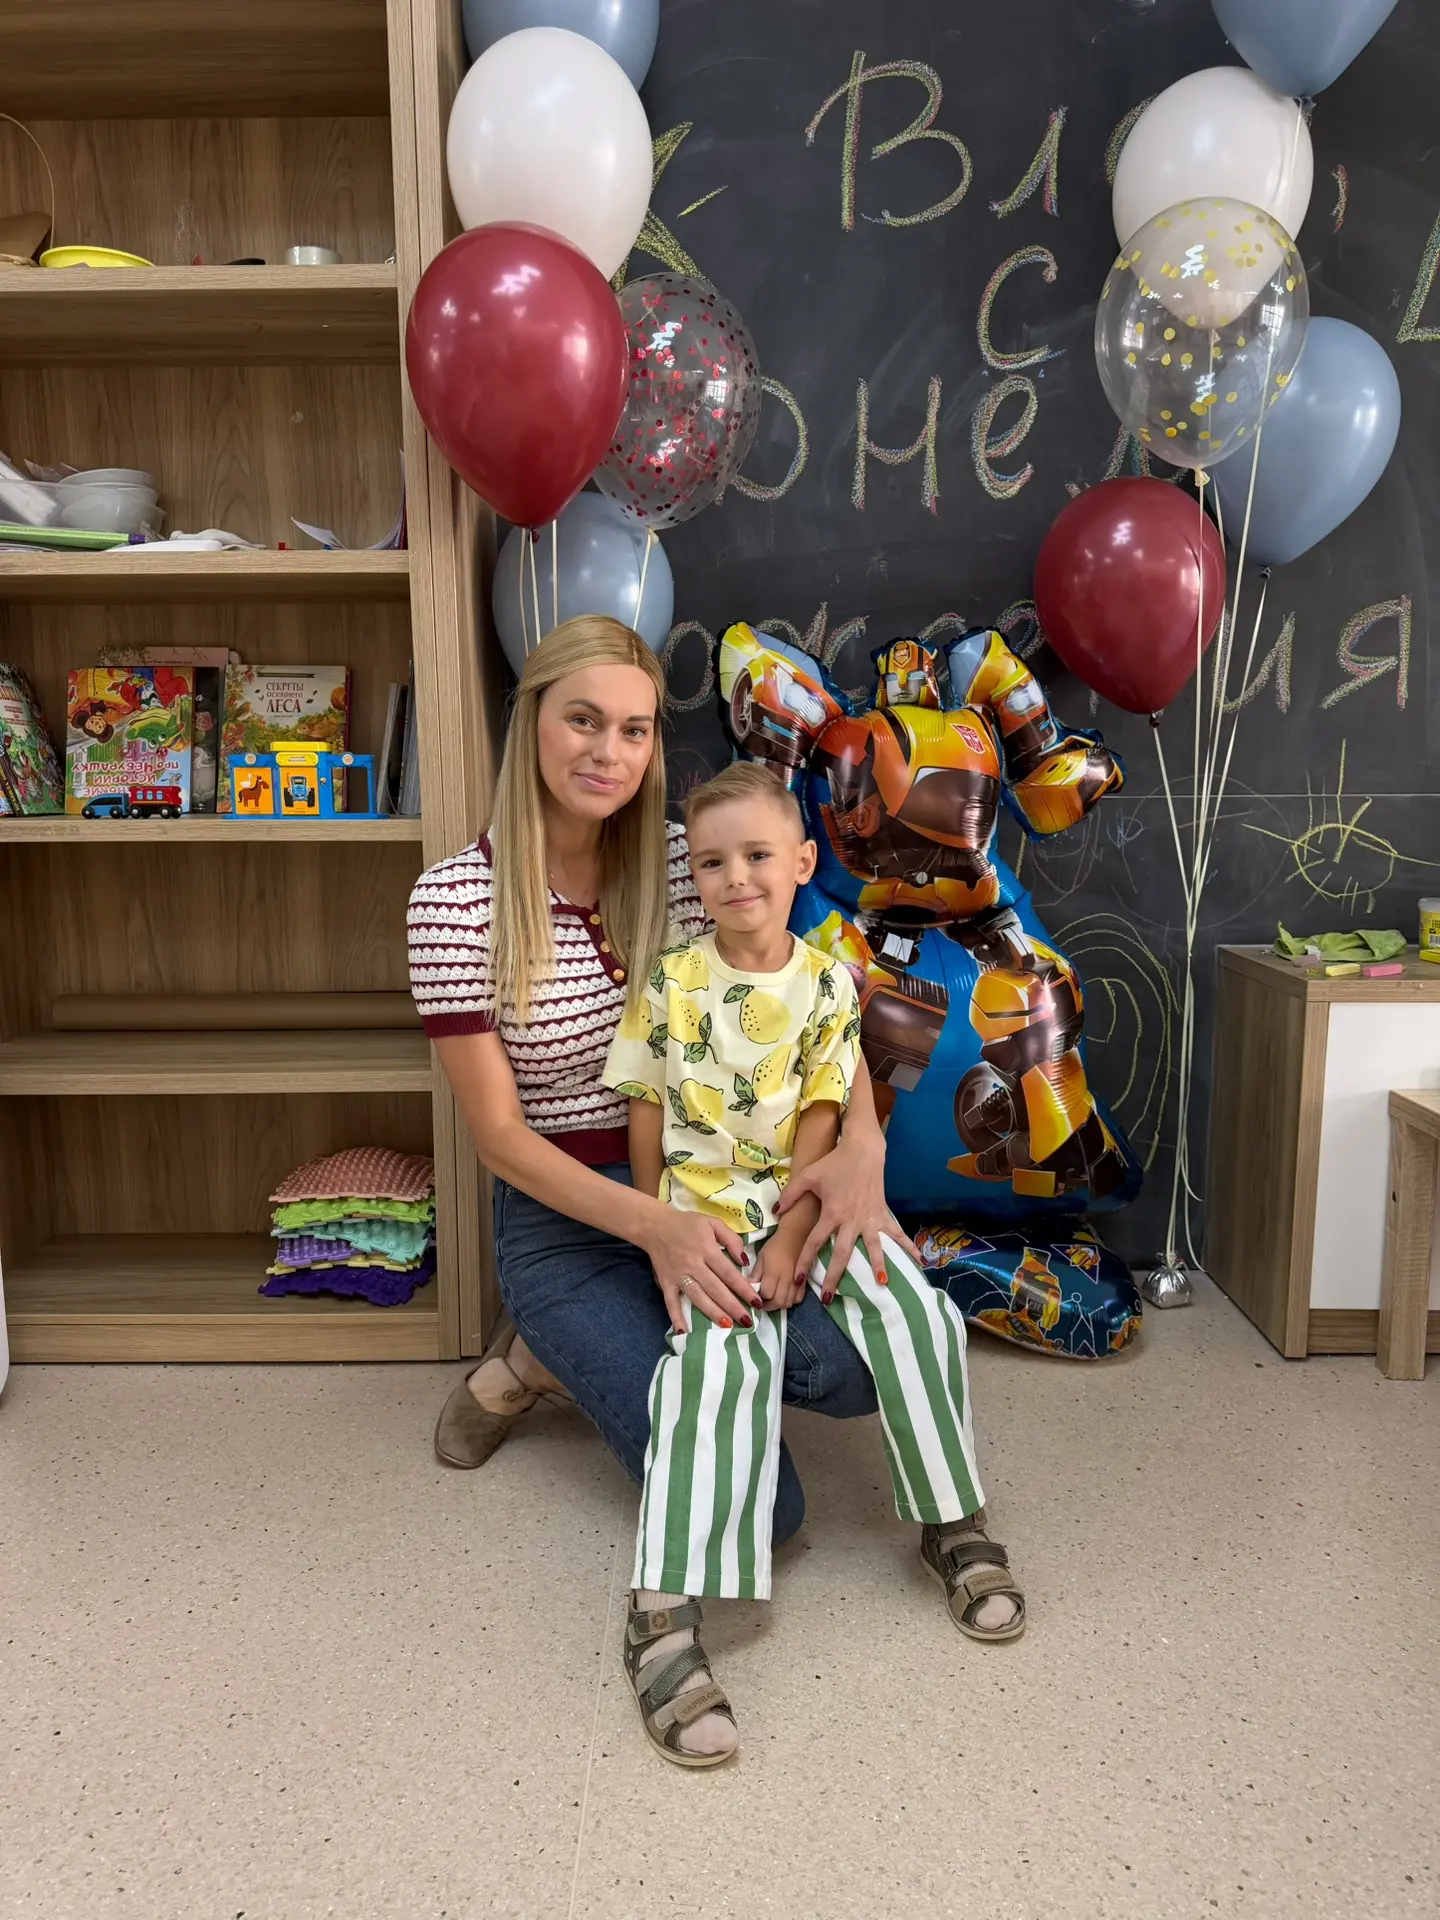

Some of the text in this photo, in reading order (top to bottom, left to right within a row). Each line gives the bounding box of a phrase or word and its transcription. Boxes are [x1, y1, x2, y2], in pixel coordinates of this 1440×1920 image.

[266, 682, 304, 691] СЕКРЕТЫ
[266, 698, 301, 713] ЛЕСА
[72, 761, 179, 773] ПРО ЧЕБУРАШКУ
[93, 773, 156, 785] ИСТОРИИ
